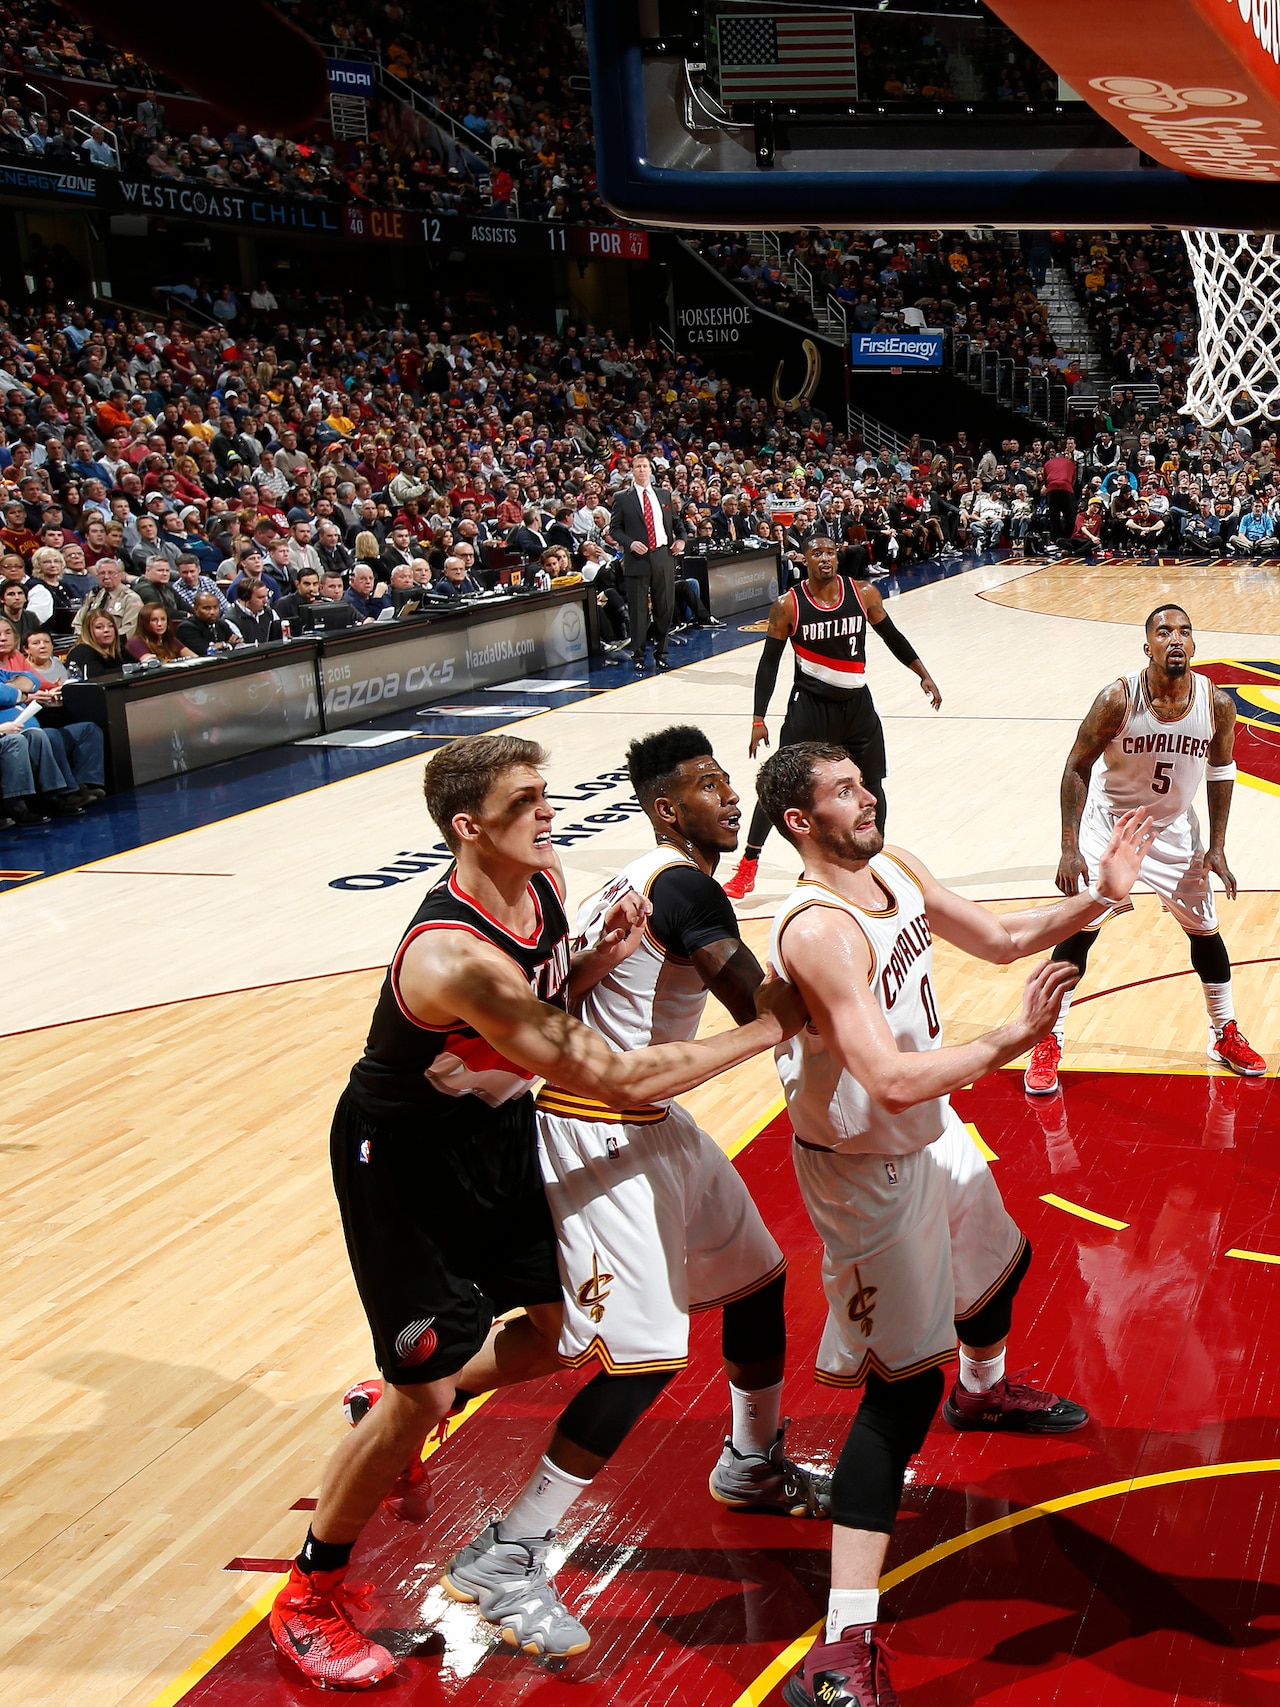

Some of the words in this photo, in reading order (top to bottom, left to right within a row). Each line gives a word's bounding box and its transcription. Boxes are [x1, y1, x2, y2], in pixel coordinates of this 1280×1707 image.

[326, 69, 371, 86] UNDAI
[118, 180, 244, 219] WESTCOAST
[350, 219, 363, 235] 40
[371, 211, 404, 239] CLE
[421, 217, 441, 242] 12
[471, 226, 517, 244] ASSISTS
[548, 229, 566, 251] 11
[589, 231, 621, 254] POR
[630, 242, 643, 256] 47
[677, 306, 750, 327] HORSESHOE
[688, 329, 739, 343] CASINO
[859, 337, 937, 357] FirstEnergy
[801, 615, 863, 641] PORTLAND
[465, 637, 535, 669] MazdaUSA.com
[849, 635, 858, 657] 2
[299, 667, 325, 688] THE
[328, 665, 351, 681] 2015
[405, 658, 456, 693] CX-5
[1122, 733, 1209, 759] CAVALIERS
[545, 764, 630, 801] Loa
[1151, 761, 1175, 795] 5
[550, 795, 643, 847] Aren
[881, 913, 933, 1010] CAVALIE
[920, 972, 940, 1039] 0
